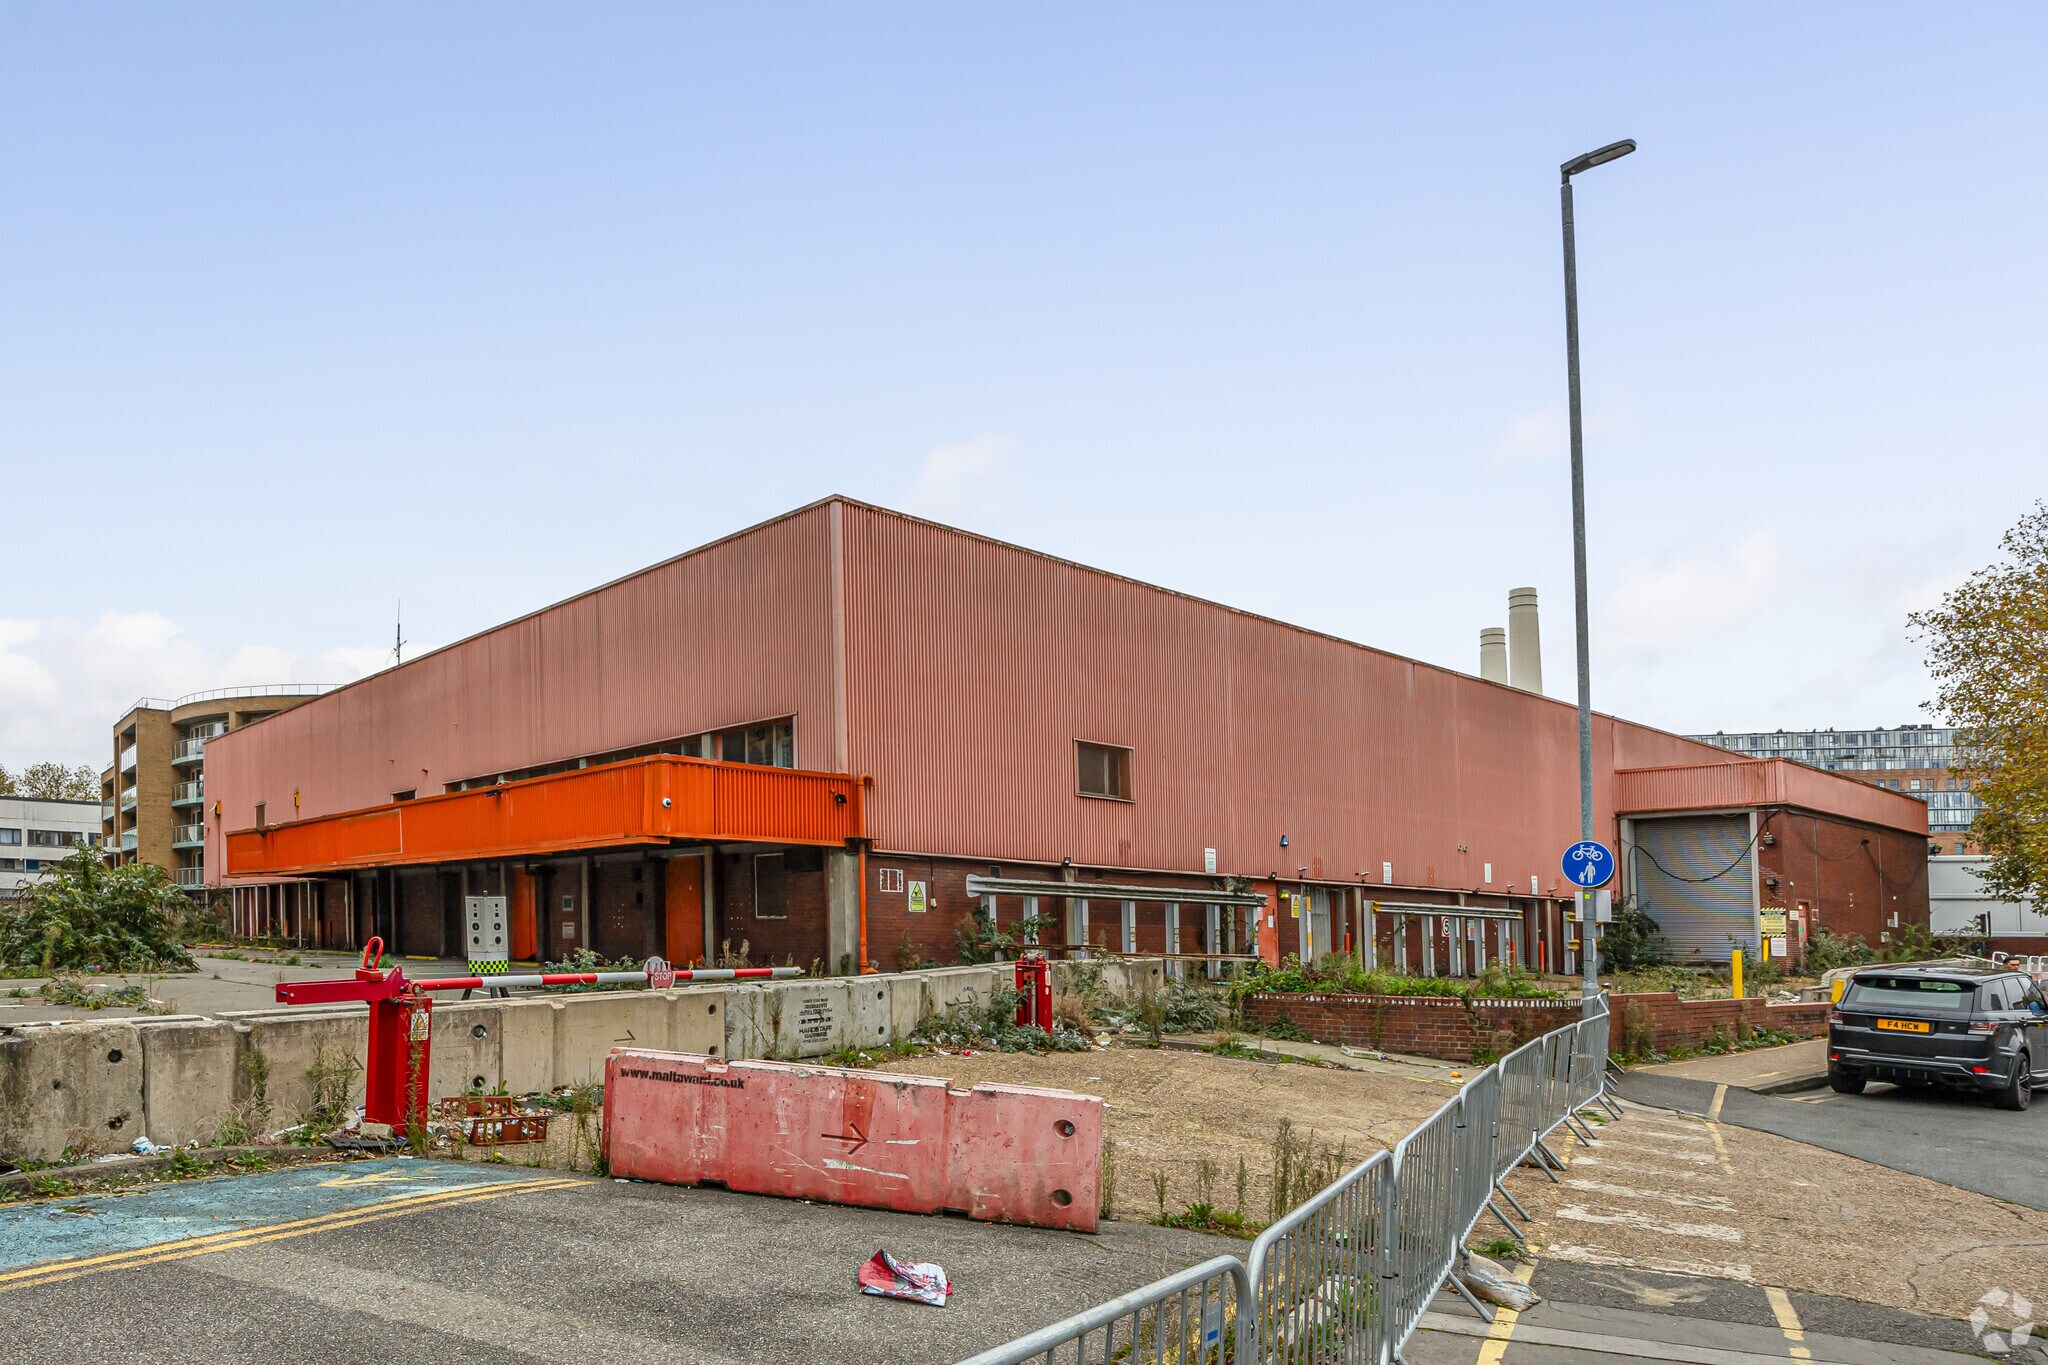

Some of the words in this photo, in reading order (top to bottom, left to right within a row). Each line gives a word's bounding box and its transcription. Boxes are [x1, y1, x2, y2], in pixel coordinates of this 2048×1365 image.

[654, 972, 672, 981] STOP
[1887, 1021, 1899, 1029] F4
[1901, 1022, 1919, 1030] HCW
[620, 1067, 745, 1090] www.maltaward.co.uk
